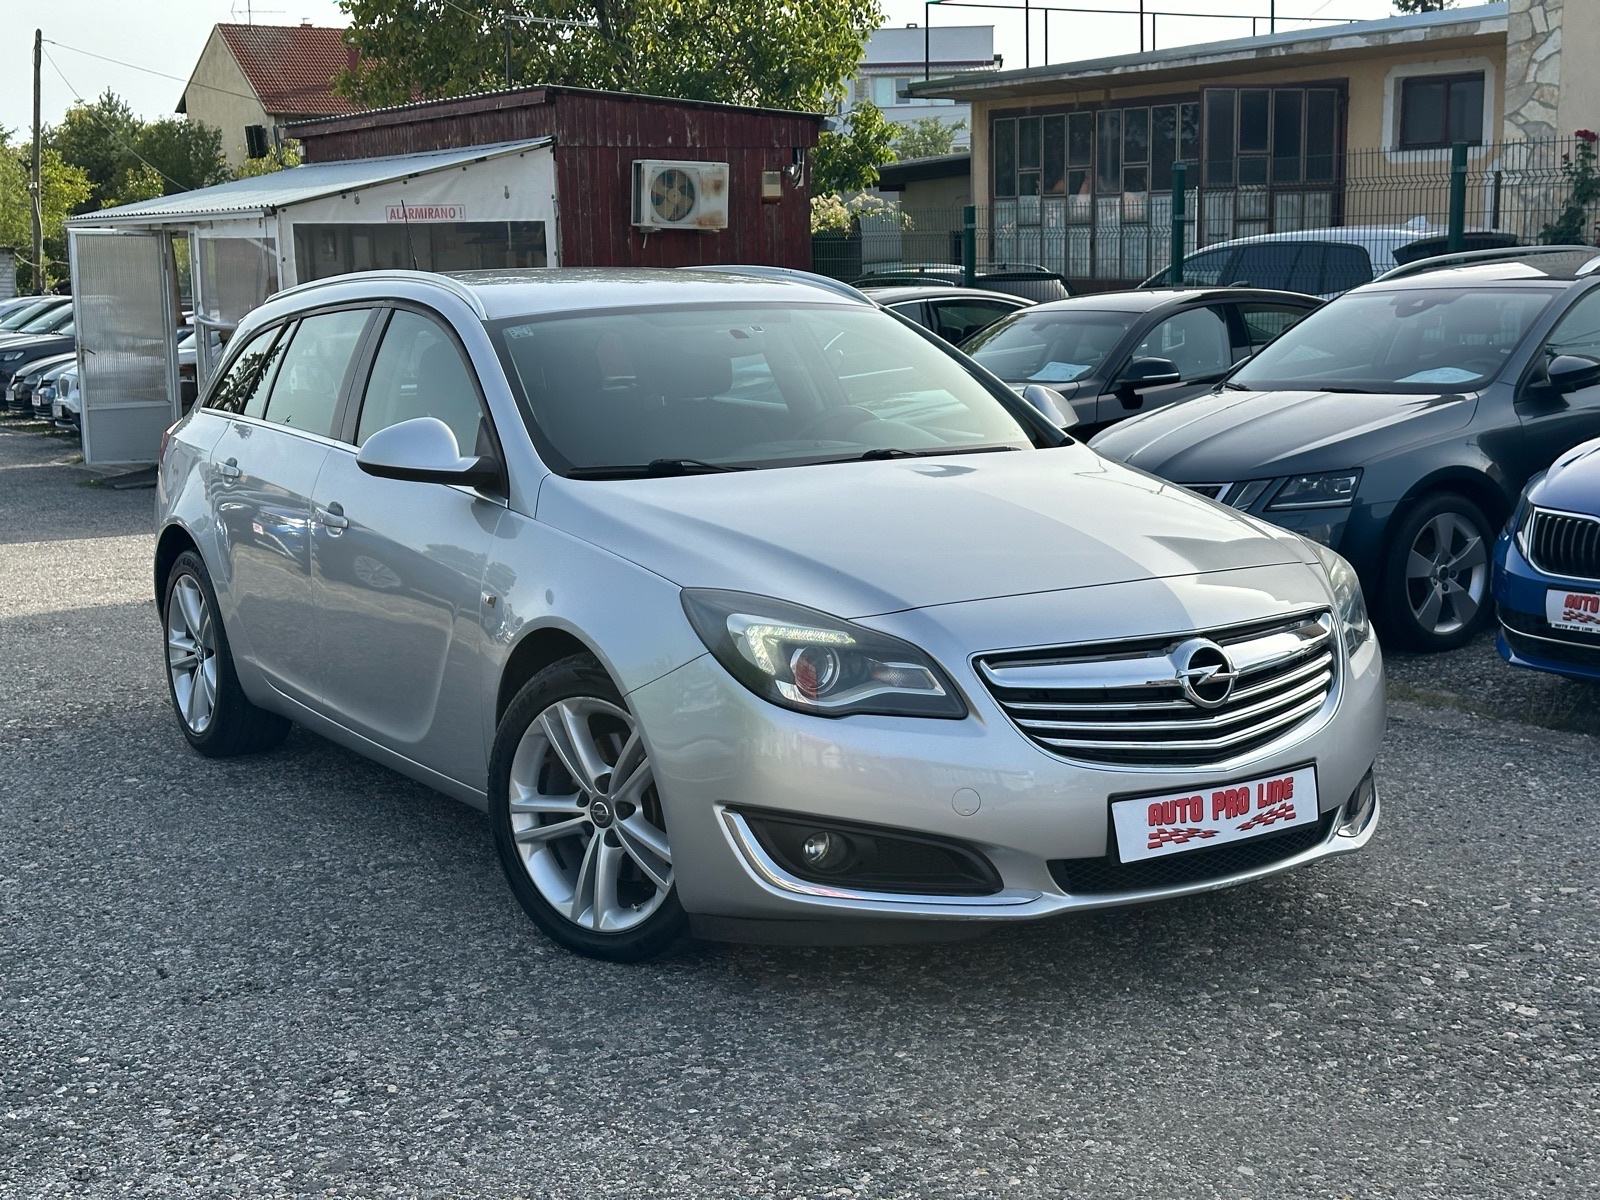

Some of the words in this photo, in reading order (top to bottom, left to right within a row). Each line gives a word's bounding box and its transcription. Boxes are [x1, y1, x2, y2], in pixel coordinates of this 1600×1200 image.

[389, 207, 456, 220] ALARMIRANO
[1564, 594, 1599, 614] AUTO
[1148, 796, 1203, 826] AUTO
[1212, 787, 1250, 820] PRO
